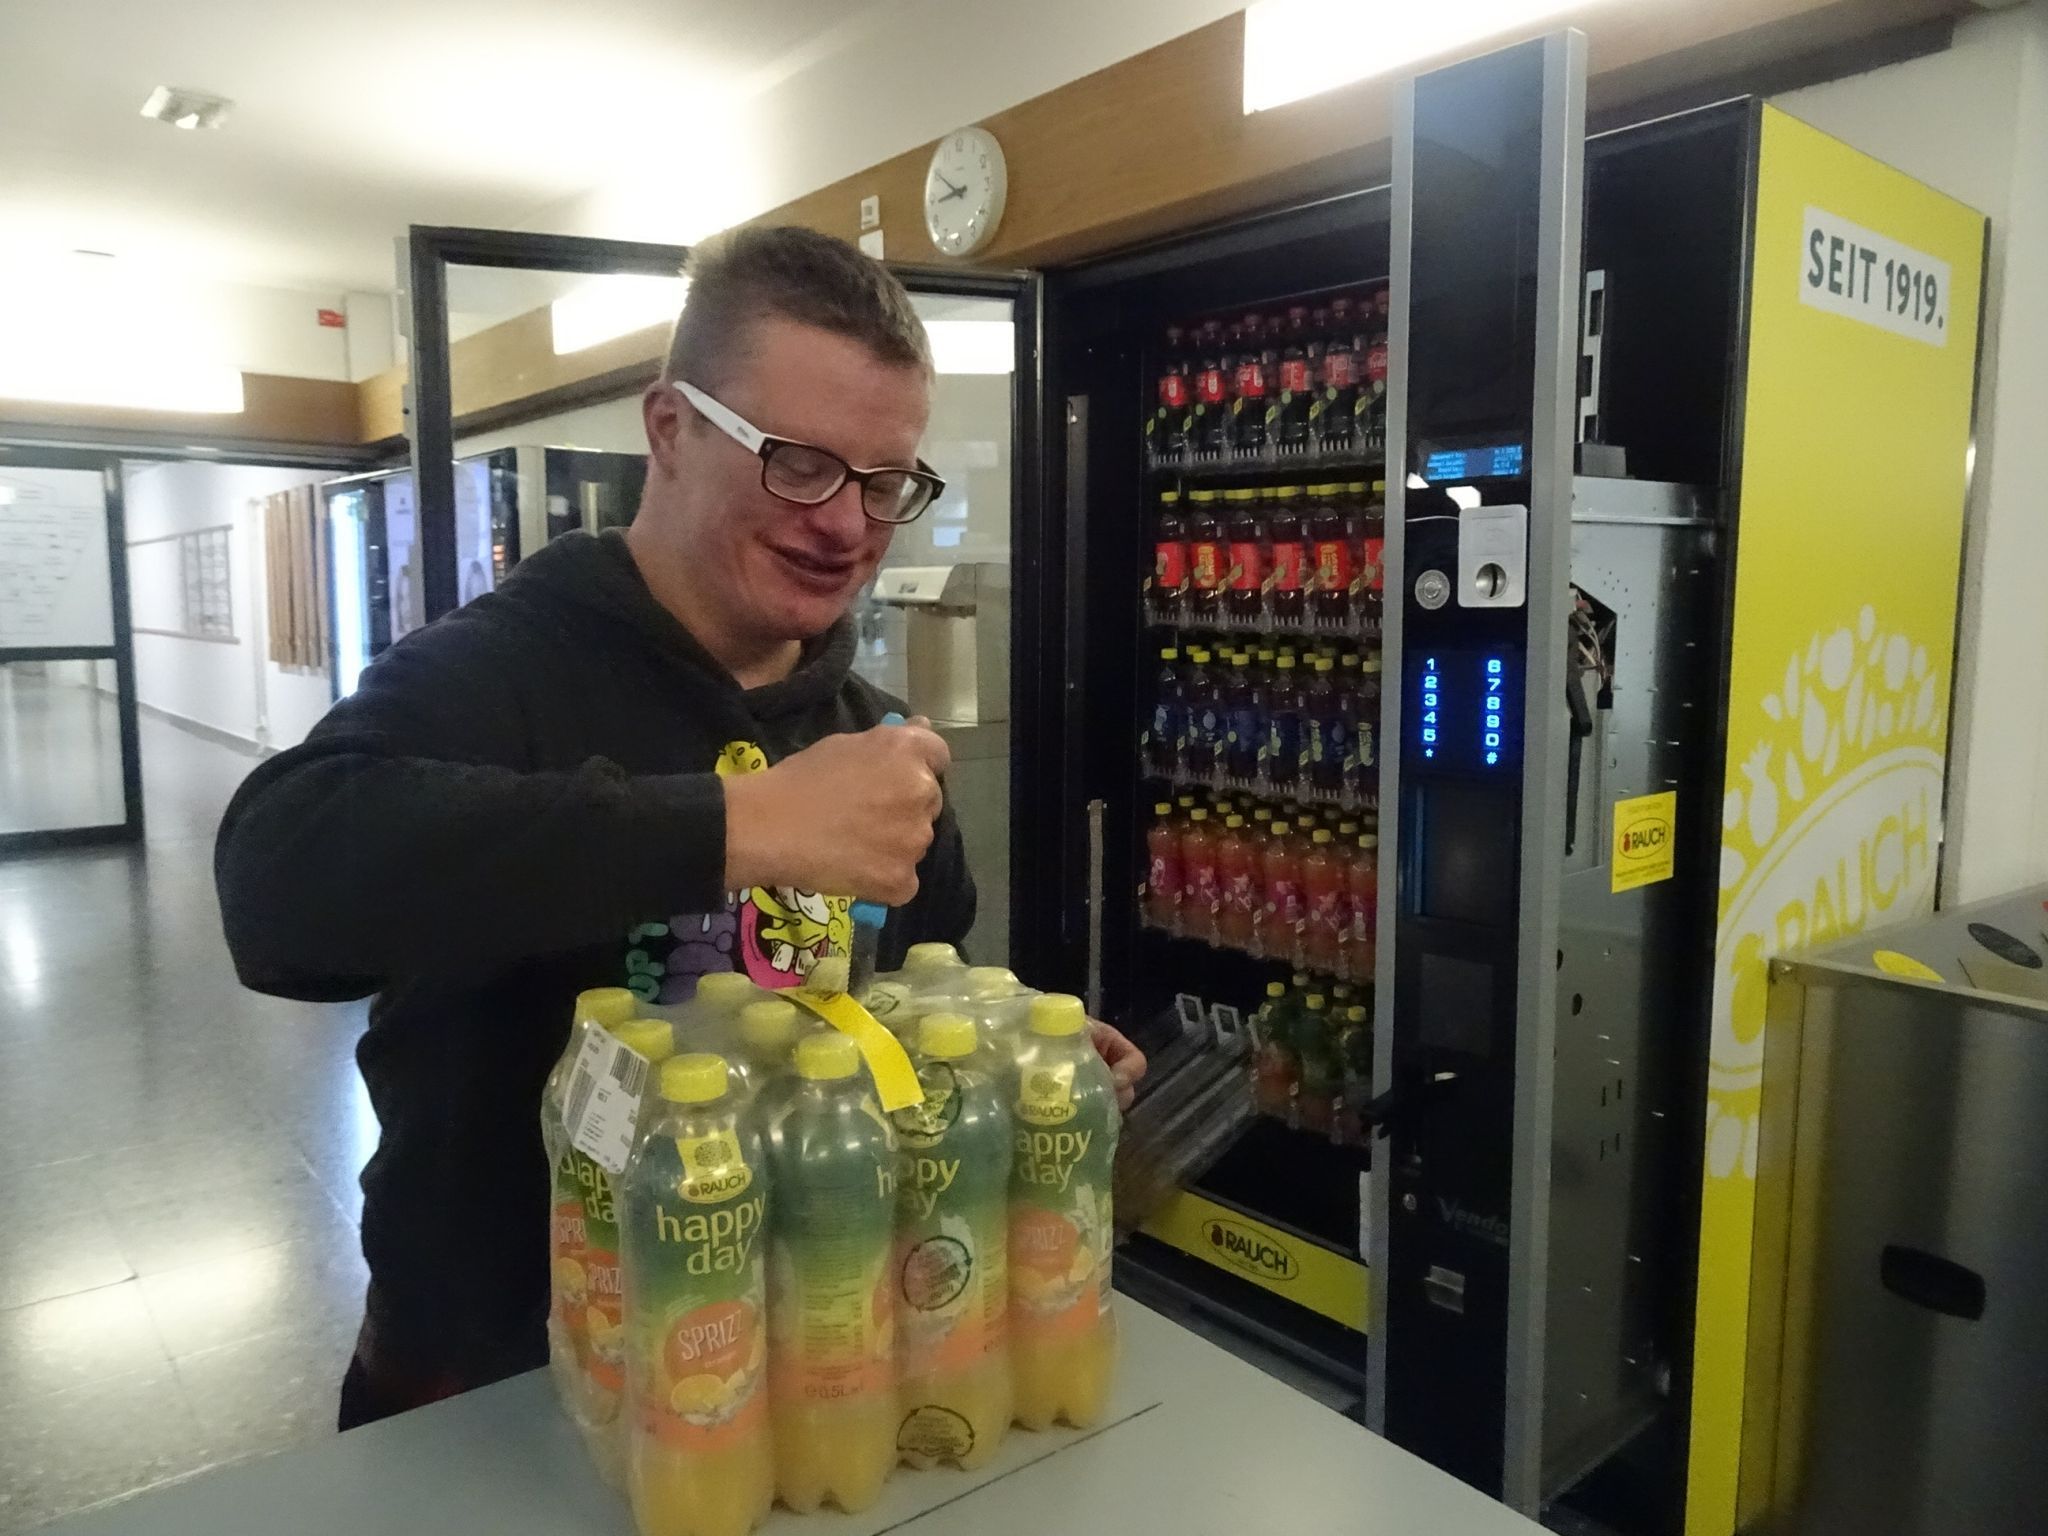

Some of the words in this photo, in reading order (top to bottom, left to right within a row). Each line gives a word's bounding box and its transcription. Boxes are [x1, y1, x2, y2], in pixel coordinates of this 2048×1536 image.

[1807, 228, 1878, 304] SEIT
[1885, 258, 1944, 330] 1919.
[1427, 658, 1435, 671] 1
[1488, 659, 1501, 673] 6
[1424, 675, 1438, 689] 2
[1488, 678, 1501, 691] 7
[1424, 693, 1437, 707] 3
[1487, 696, 1500, 710] 8
[1424, 711, 1436, 724] 4
[1486, 714, 1500, 728] 9
[1423, 728, 1436, 742] 5
[1485, 733, 1499, 747] 0
[1631, 825, 1666, 850] RAUCH
[1016, 1128, 1092, 1163] appy
[700, 1173, 746, 1195] RAUCH
[585, 1191, 616, 1223] da
[656, 1191, 766, 1249] happy
[686, 1236, 753, 1275] day
[1225, 1230, 1288, 1275] RAUCH
